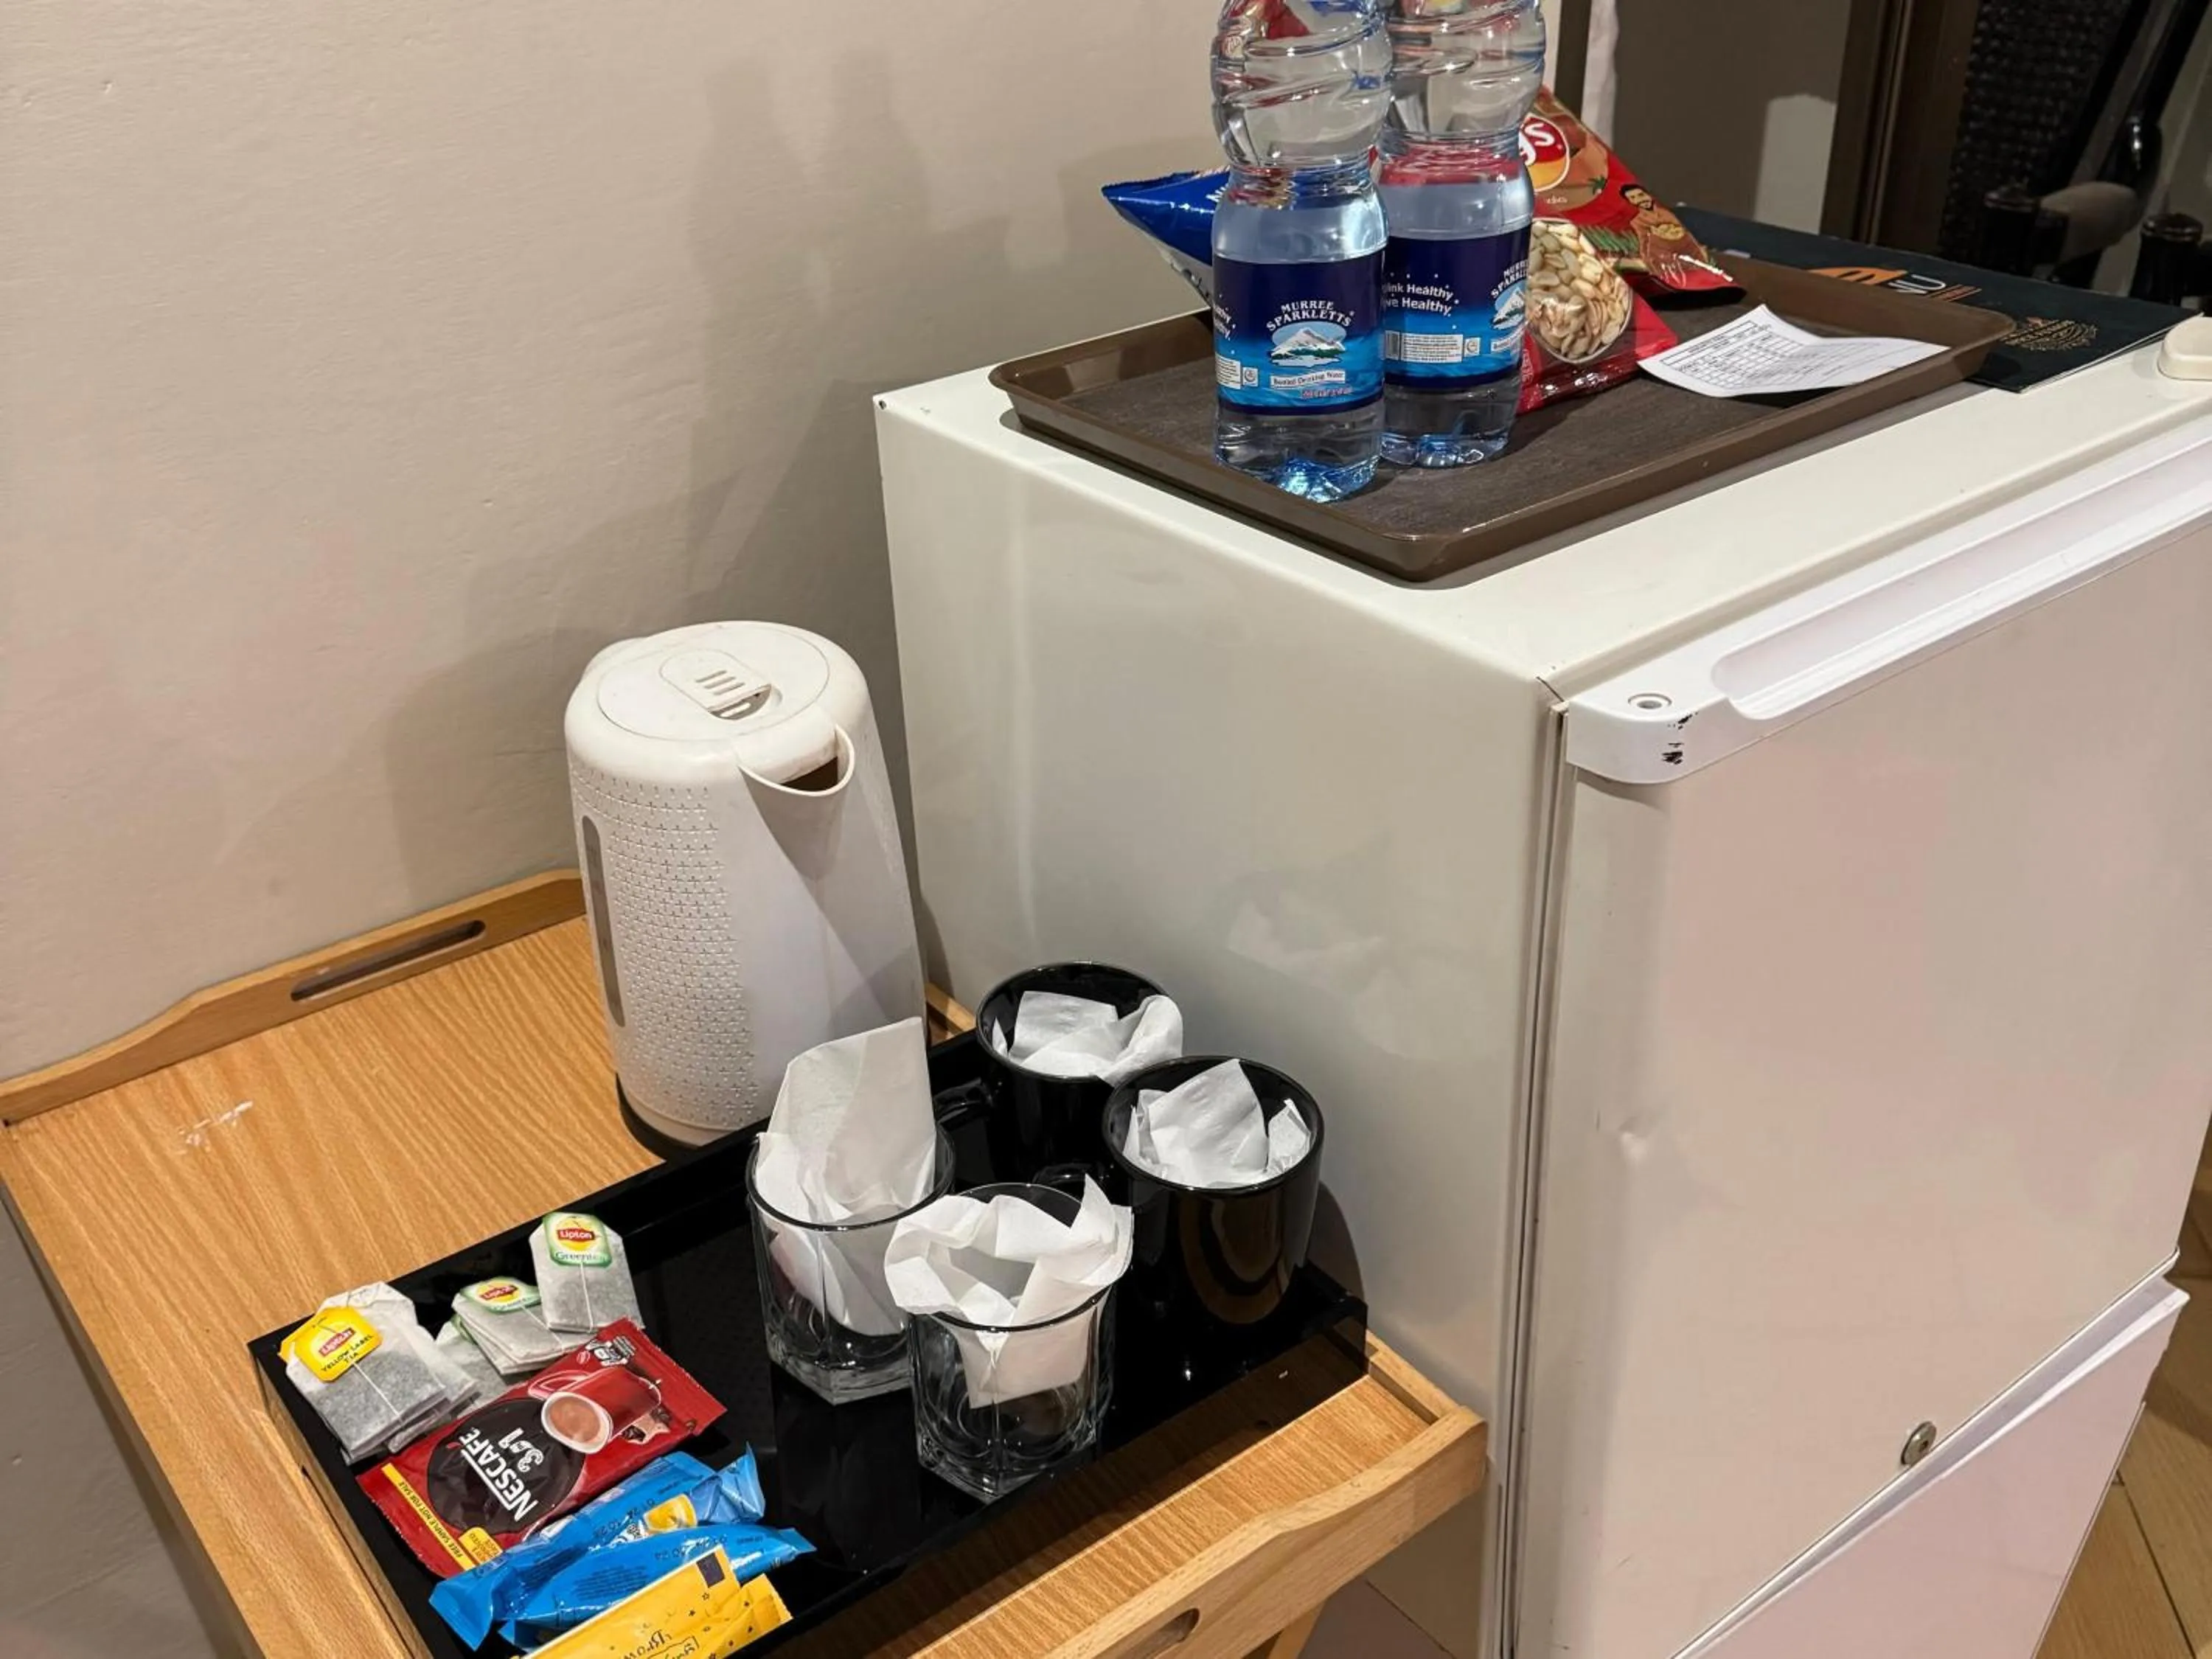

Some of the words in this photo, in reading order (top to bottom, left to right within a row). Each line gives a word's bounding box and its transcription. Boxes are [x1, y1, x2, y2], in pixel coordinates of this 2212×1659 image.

[1406, 283, 1453, 301] Healthy
[1281, 299, 1334, 313] MURREE
[1266, 310, 1352, 331] SPARKLETTS
[560, 1230, 592, 1241] Lipton
[321, 1350, 349, 1371] YELLOW
[350, 1334, 373, 1352] LABEL
[343, 1352, 359, 1363] TEA
